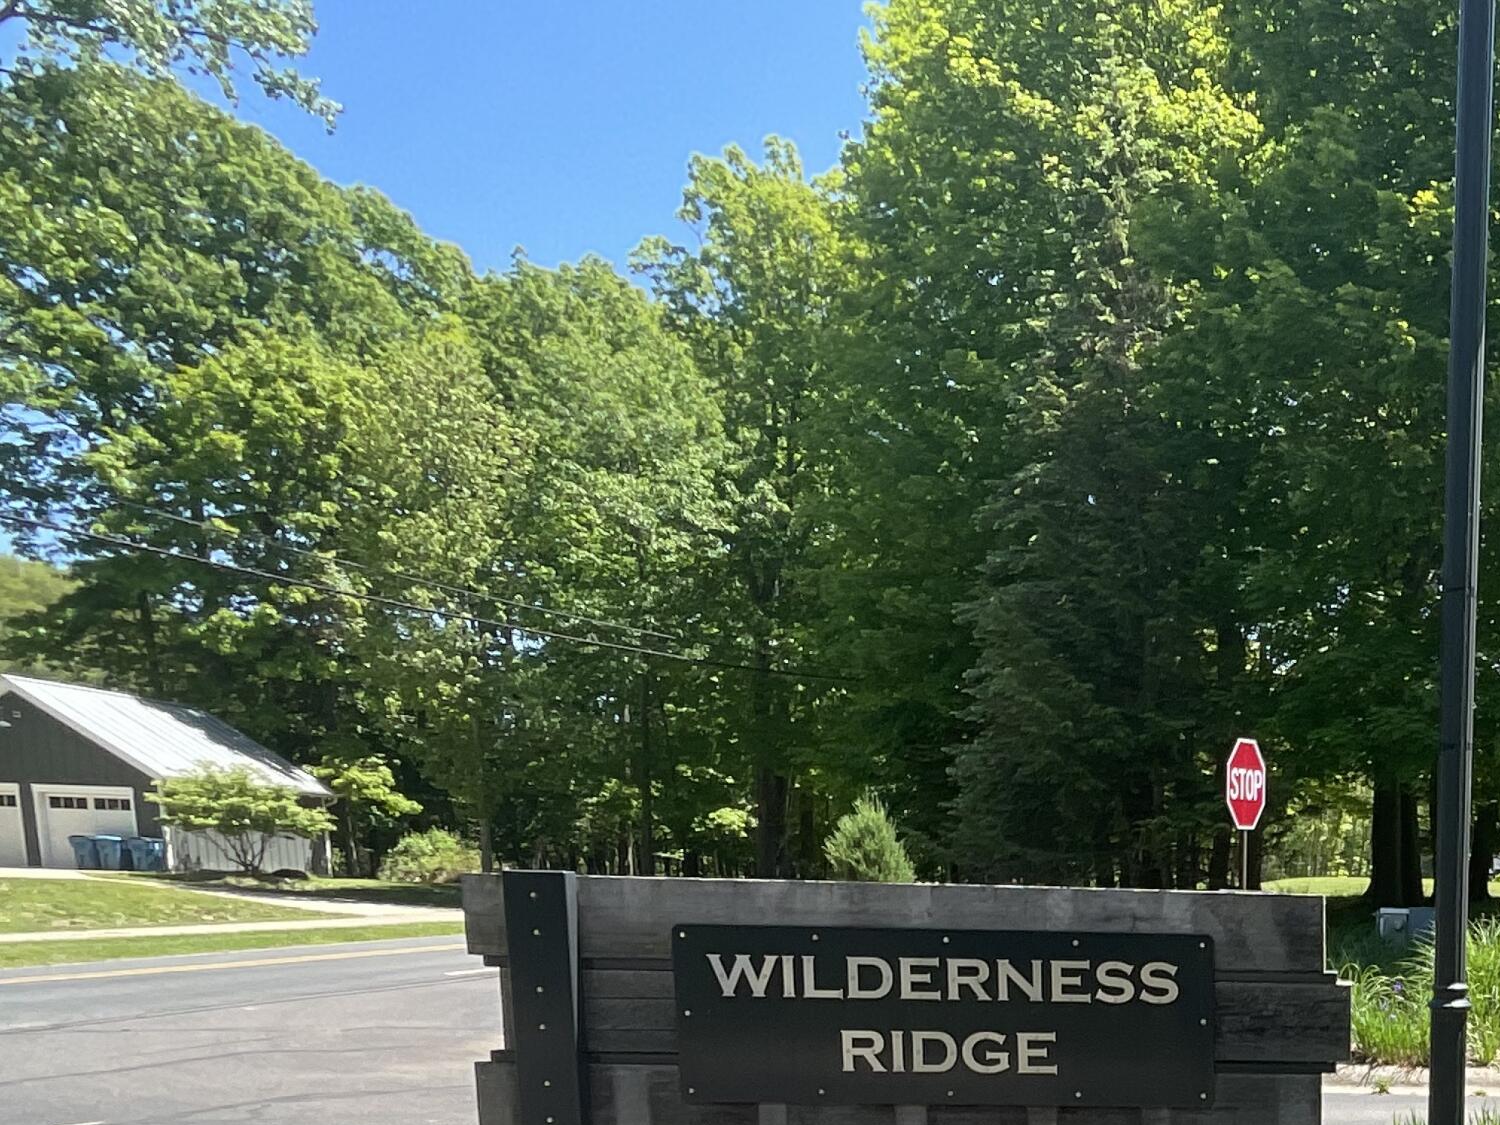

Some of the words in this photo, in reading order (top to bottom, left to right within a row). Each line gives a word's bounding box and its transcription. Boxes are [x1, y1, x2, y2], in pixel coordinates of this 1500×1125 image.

[1230, 767, 1263, 801] STOP
[706, 953, 1180, 1005] WILDERNESS
[840, 1029, 1058, 1075] RIDGE
